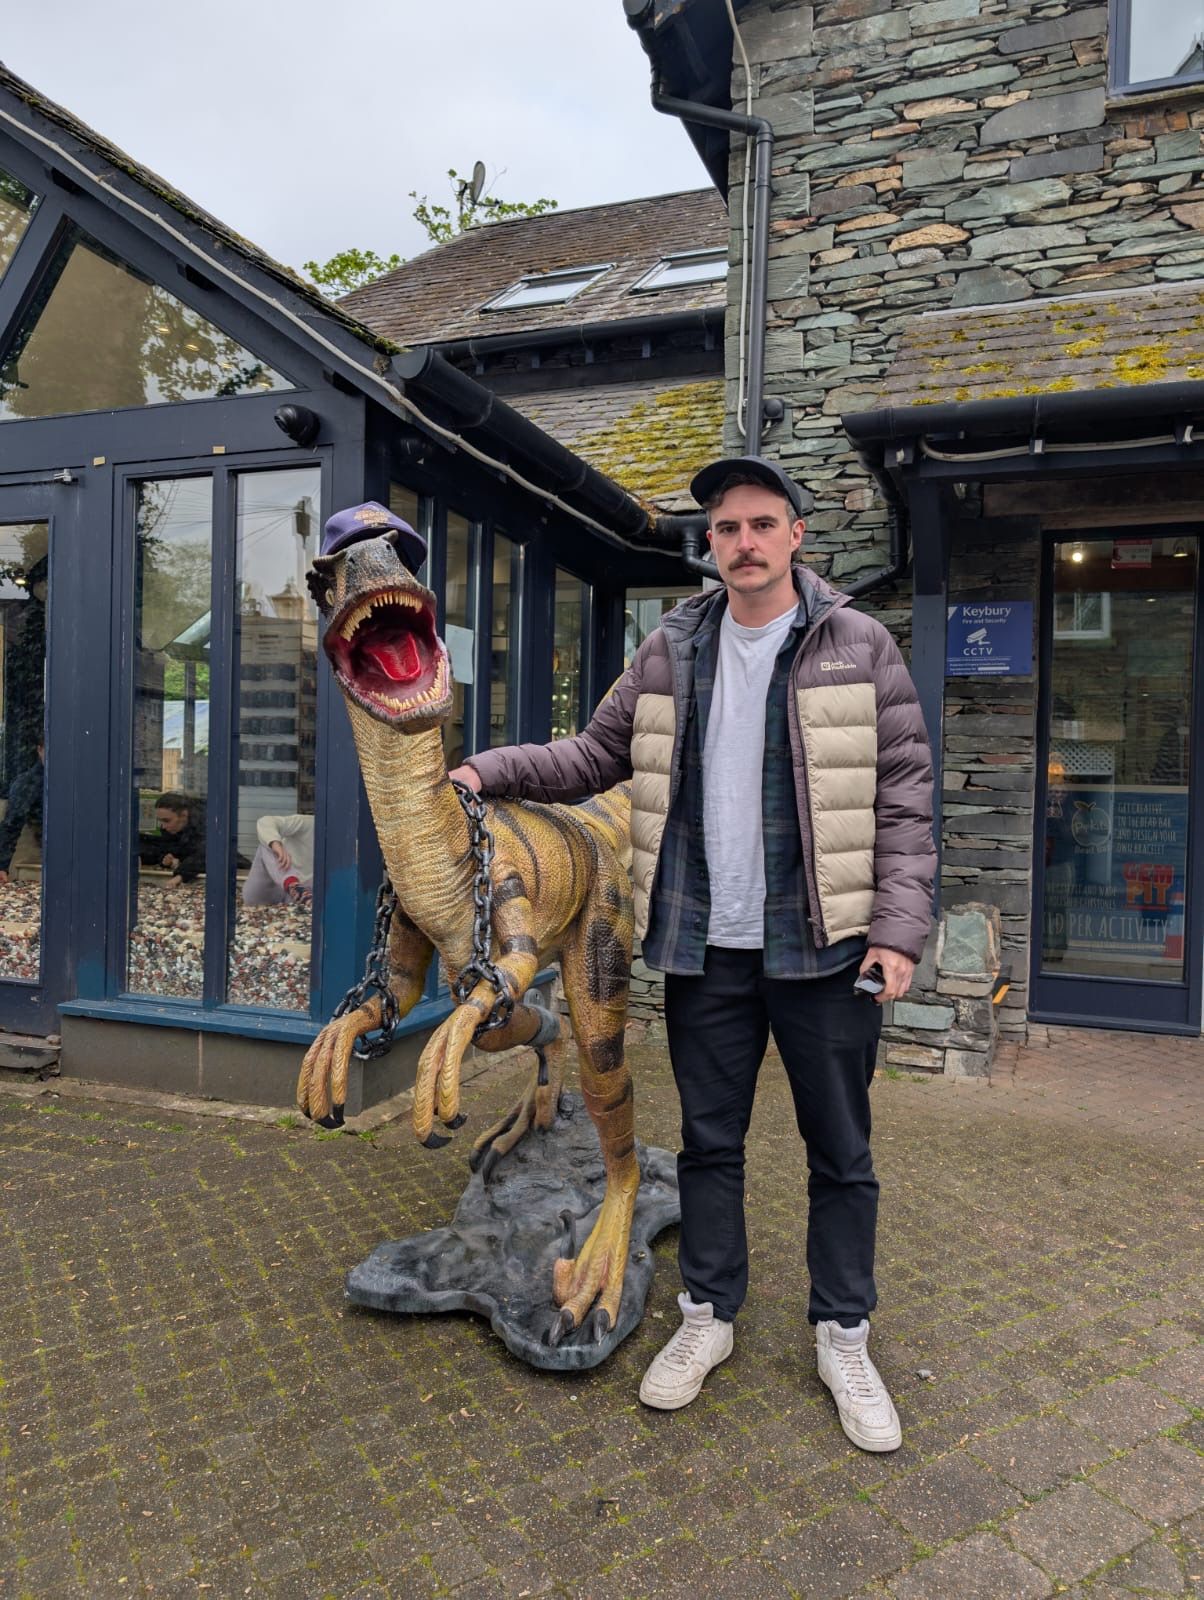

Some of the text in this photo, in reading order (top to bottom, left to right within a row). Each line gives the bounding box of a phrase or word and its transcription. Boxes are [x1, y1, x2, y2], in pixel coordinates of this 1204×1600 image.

[963, 605, 1011, 618] Keybury
[963, 647, 993, 656] CCTV
[1117, 815, 1126, 826] IN
[1133, 830, 1158, 841] DESIGN
[1160, 831, 1176, 842] YOUR
[1122, 864, 1174, 885] GEM
[1127, 880, 1169, 904] PIT
[1069, 913, 1093, 937] PER
